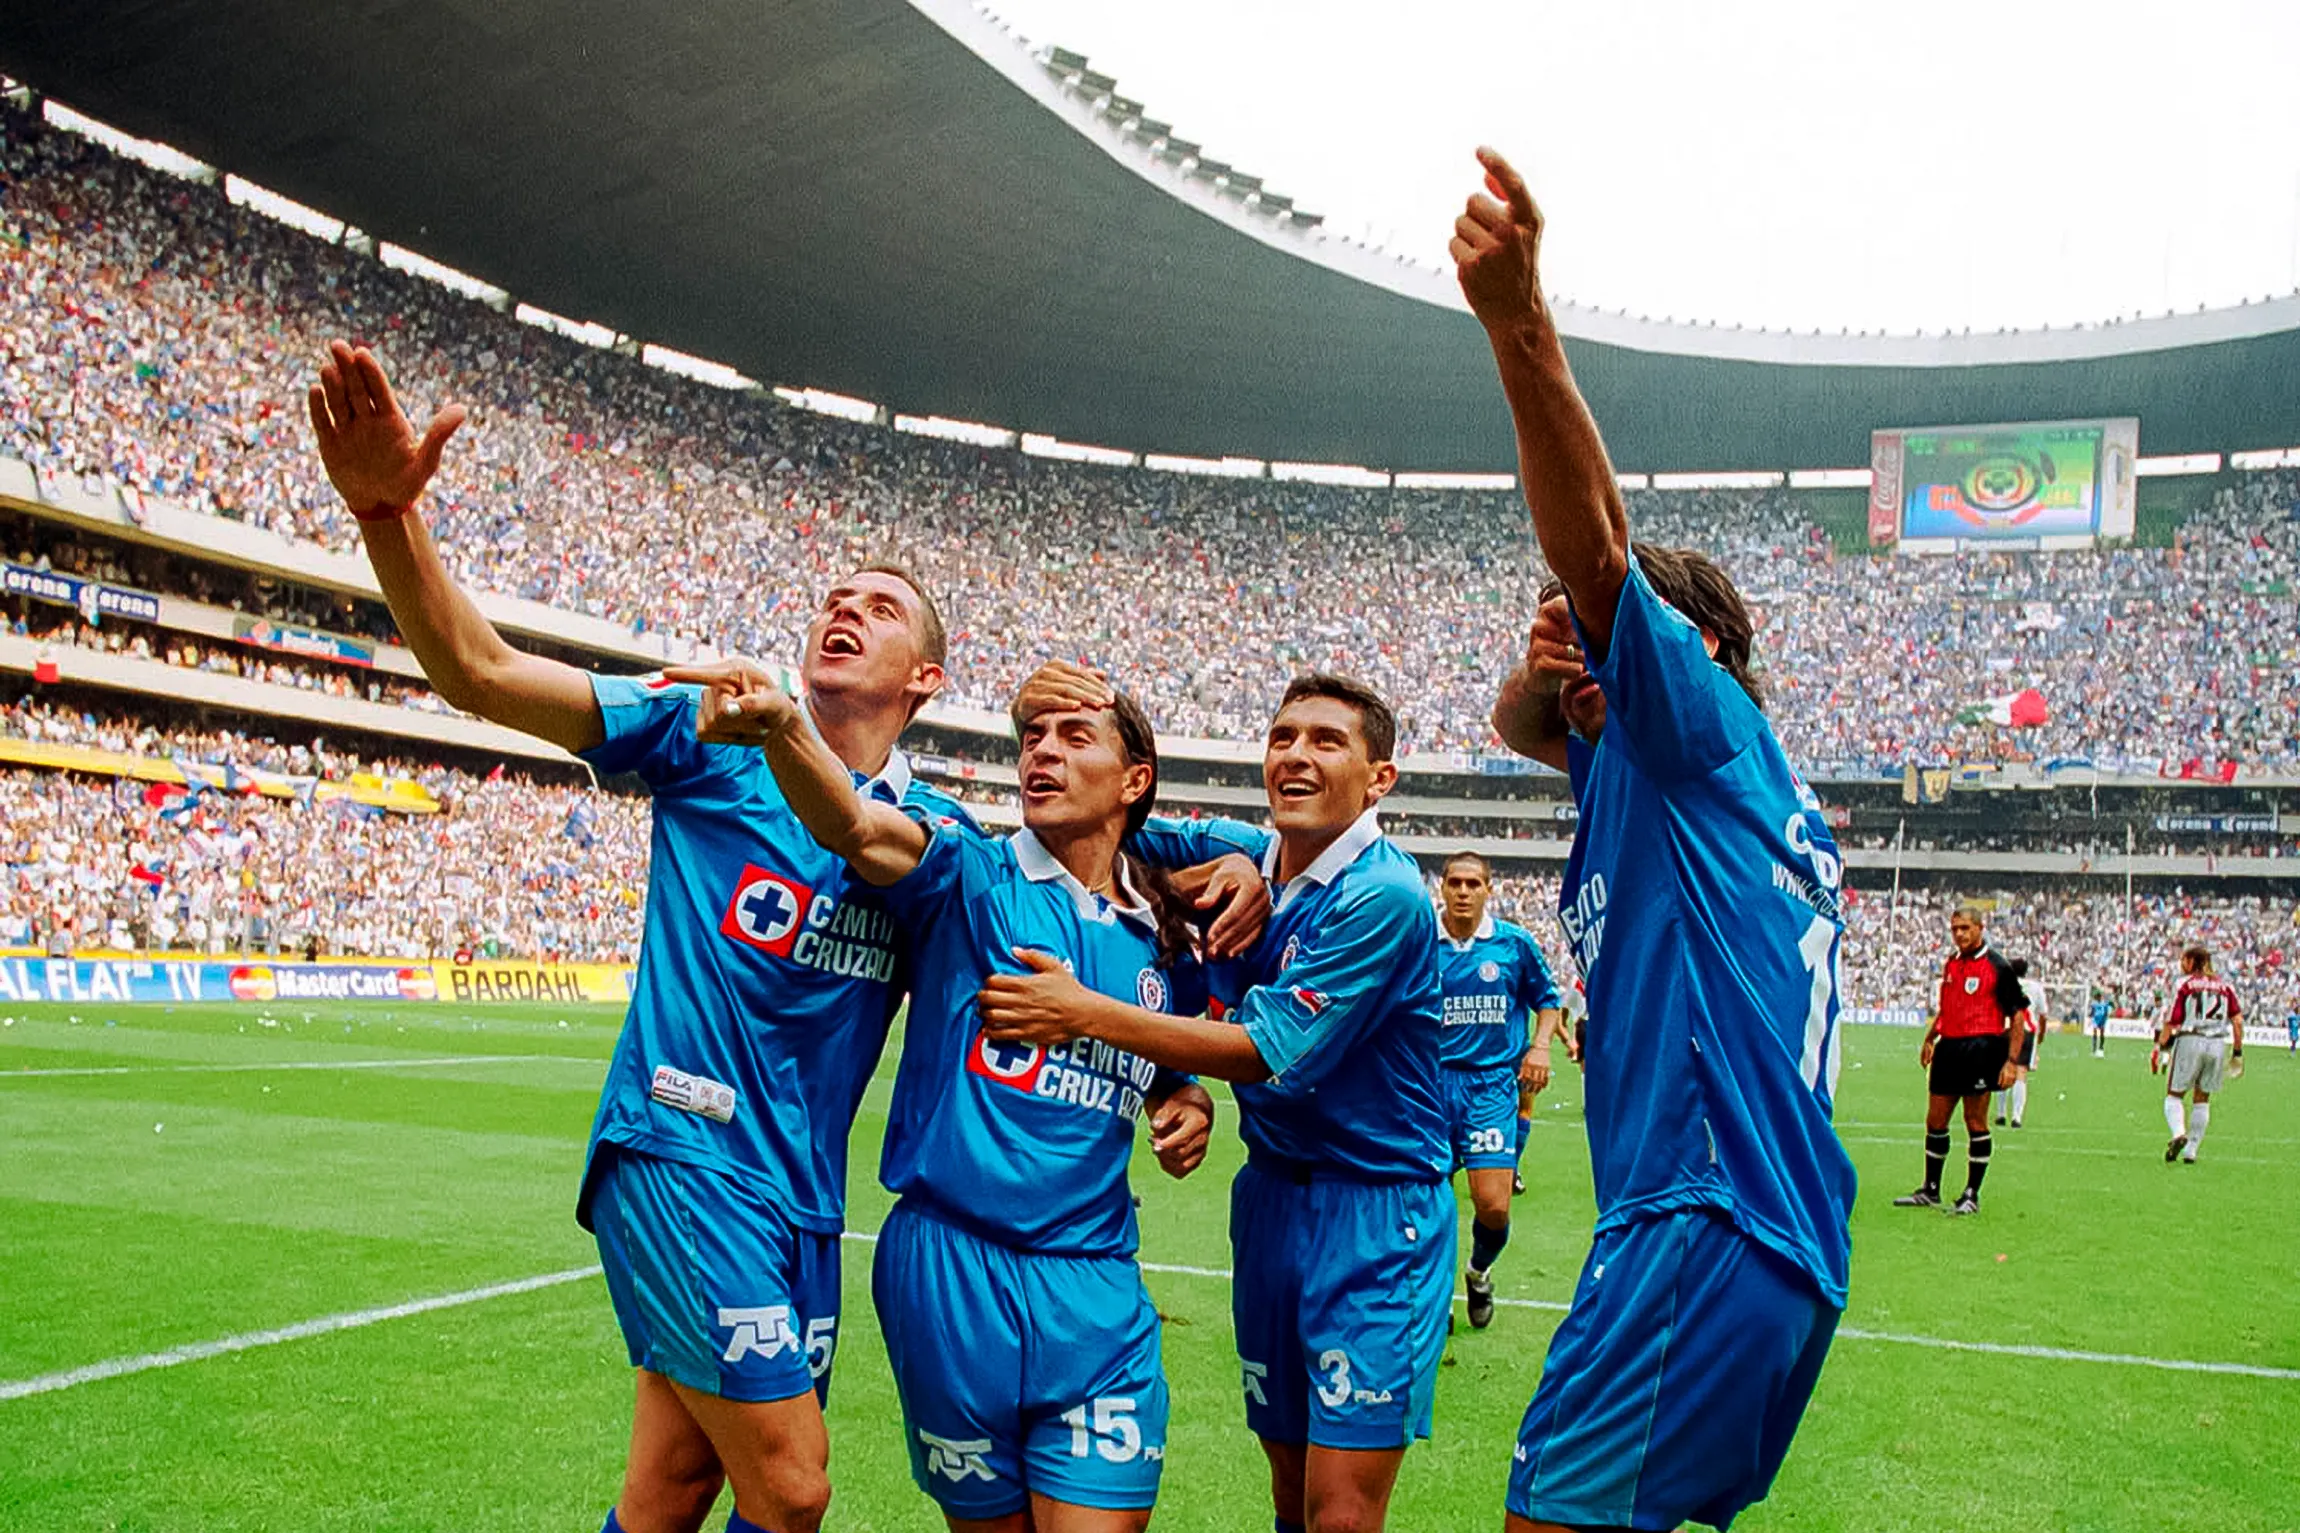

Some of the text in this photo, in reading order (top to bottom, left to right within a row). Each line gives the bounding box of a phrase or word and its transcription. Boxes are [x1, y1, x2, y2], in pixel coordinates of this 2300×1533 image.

[46, 961, 132, 1000] FLAT
[165, 963, 200, 1001] TV
[277, 970, 399, 998] MasterCard
[452, 970, 589, 1001] BARDAHL
[1443, 995, 1507, 1010] CEMENTO
[2191, 992, 2223, 1020] 12
[655, 1071, 692, 1092] FILA
[1036, 1064, 1116, 1113] CRUZ
[1469, 1128, 1504, 1154] 20
[1317, 1349, 1351, 1407] 3
[1354, 1389, 1393, 1403] FILA
[1061, 1398, 1142, 1463] 15
